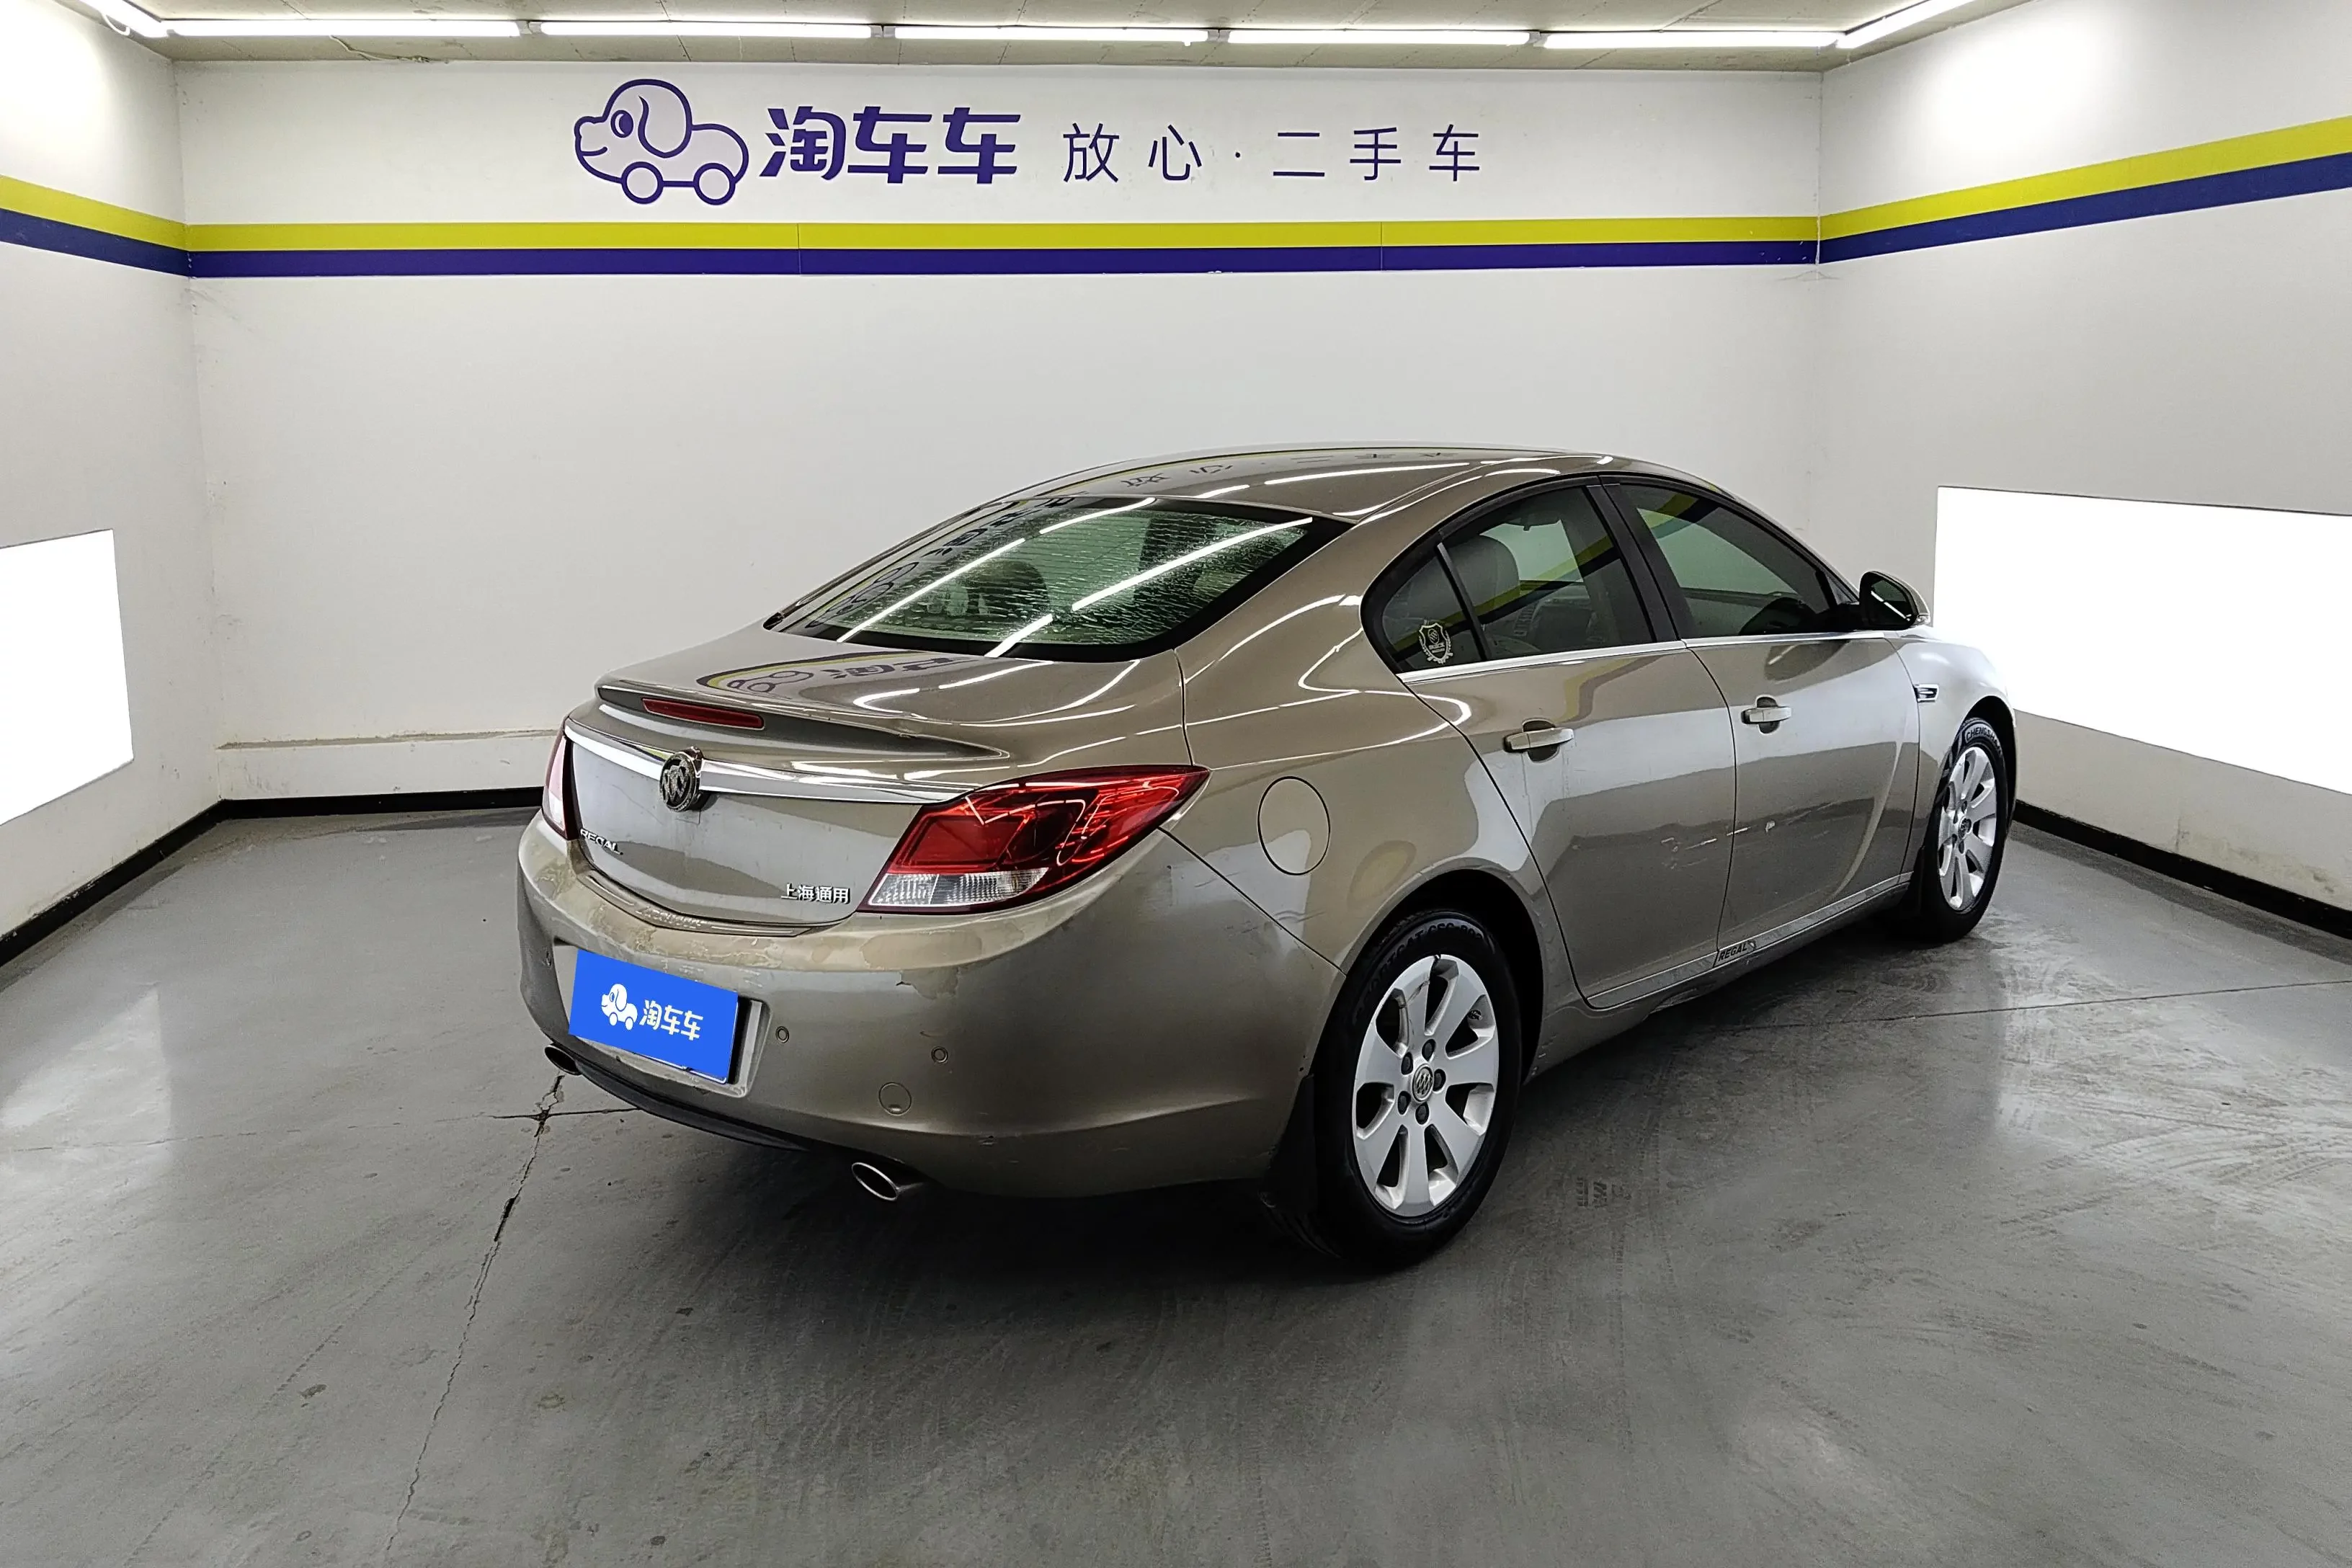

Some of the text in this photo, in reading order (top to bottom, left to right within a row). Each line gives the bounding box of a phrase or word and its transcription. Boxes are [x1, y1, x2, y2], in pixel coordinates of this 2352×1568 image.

[760, 105, 1021, 184] 淘车车
[579, 828, 621, 855] REGAL
[780, 883, 850, 904] 上海通用
[1718, 943, 1747, 962] REGAL
